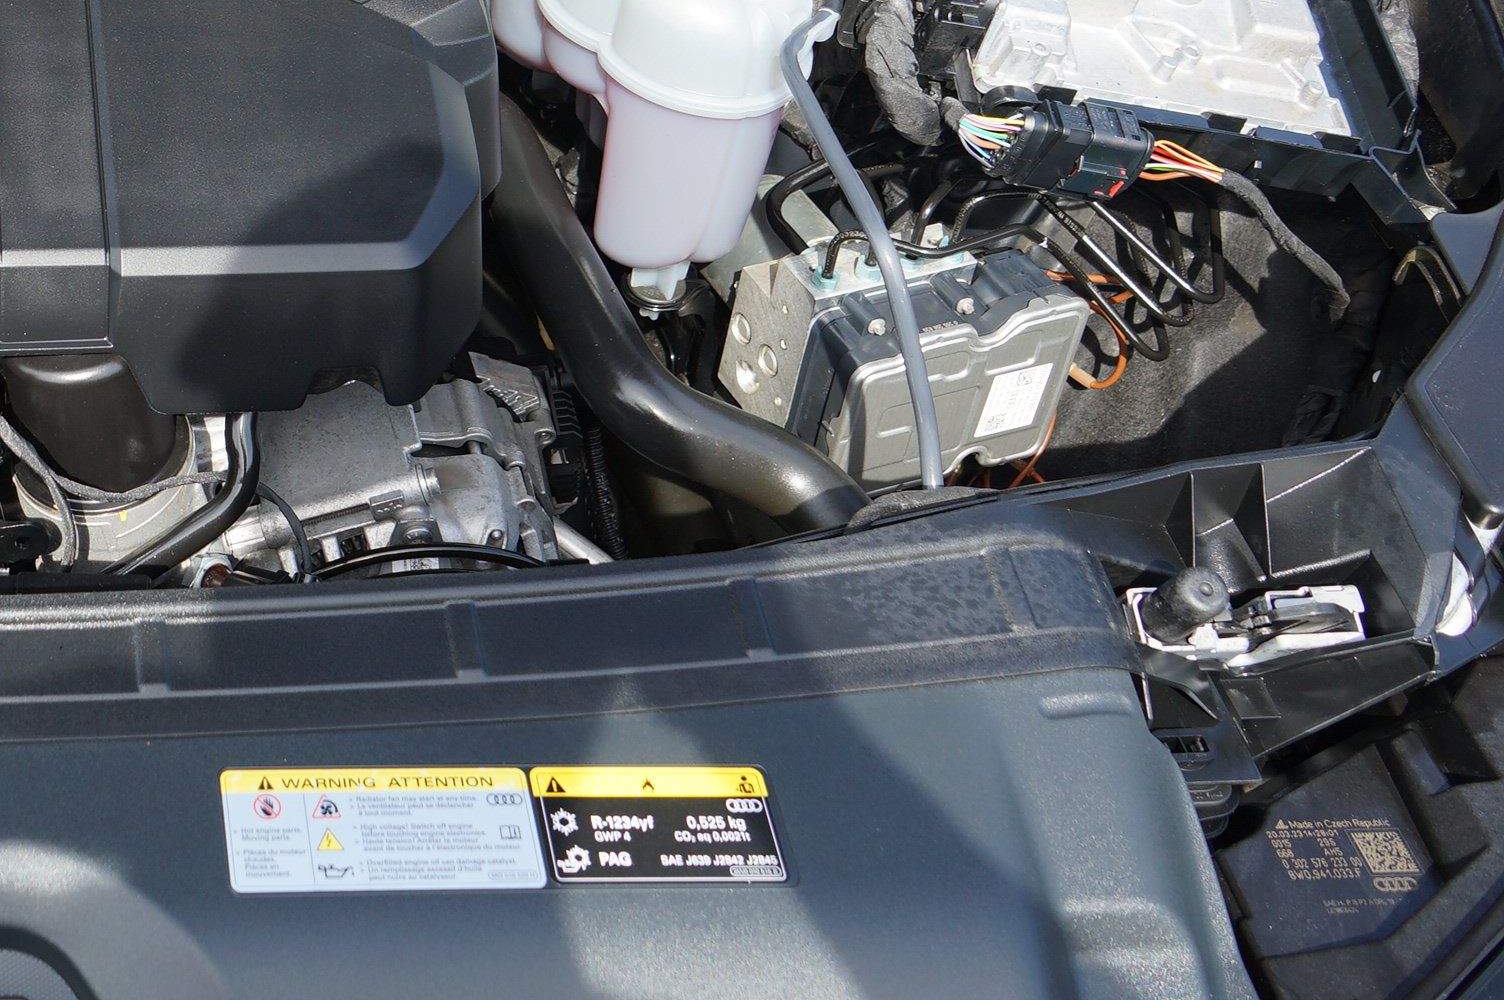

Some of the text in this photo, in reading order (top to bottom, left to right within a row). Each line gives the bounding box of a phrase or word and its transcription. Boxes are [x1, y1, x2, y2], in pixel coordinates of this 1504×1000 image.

[282, 776, 493, 788] WARNING ATTENTION
[590, 814, 655, 832] R-1234yf
[686, 815, 747, 832] 0,525 kg
[1288, 818, 1391, 830] Made in Czech Republic
[594, 831, 632, 843] GWP 4
[1271, 839, 1292, 848] 0015
[598, 851, 633, 867] PAG
[660, 854, 779, 867] SAE J639 J2842 J2845
[1293, 858, 1308, 868] 302
[1312, 857, 1329, 868] 576
[1332, 857, 1349, 867] 233
